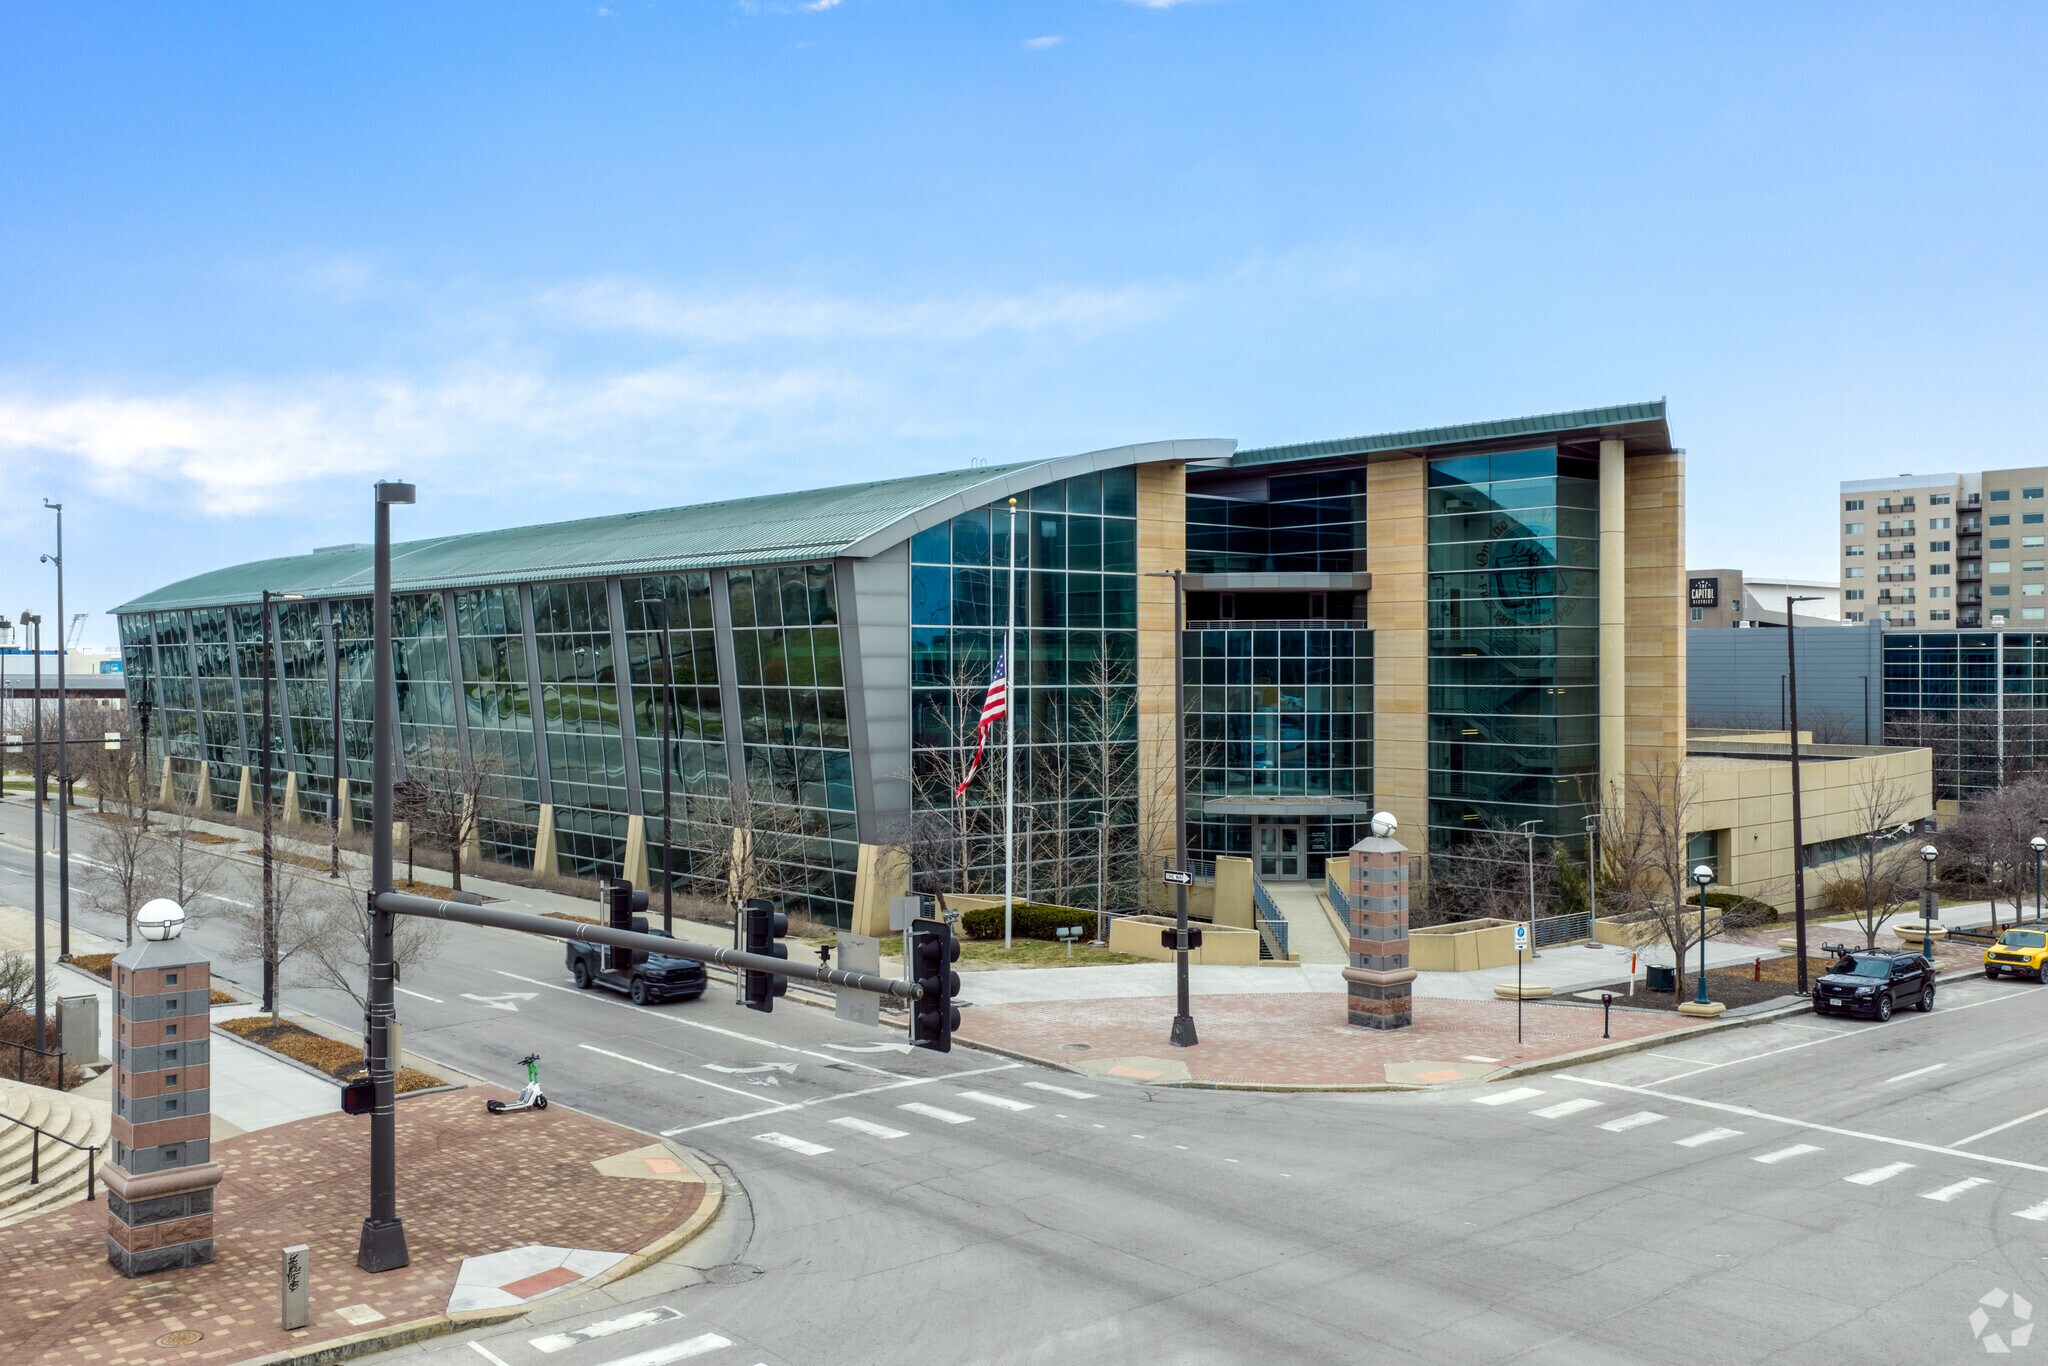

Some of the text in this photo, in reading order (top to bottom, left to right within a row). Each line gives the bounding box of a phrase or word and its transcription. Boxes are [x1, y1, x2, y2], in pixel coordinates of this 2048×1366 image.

[1692, 588, 1714, 599] CAPITOL
[1512, 607, 1552, 616] Since 1885
